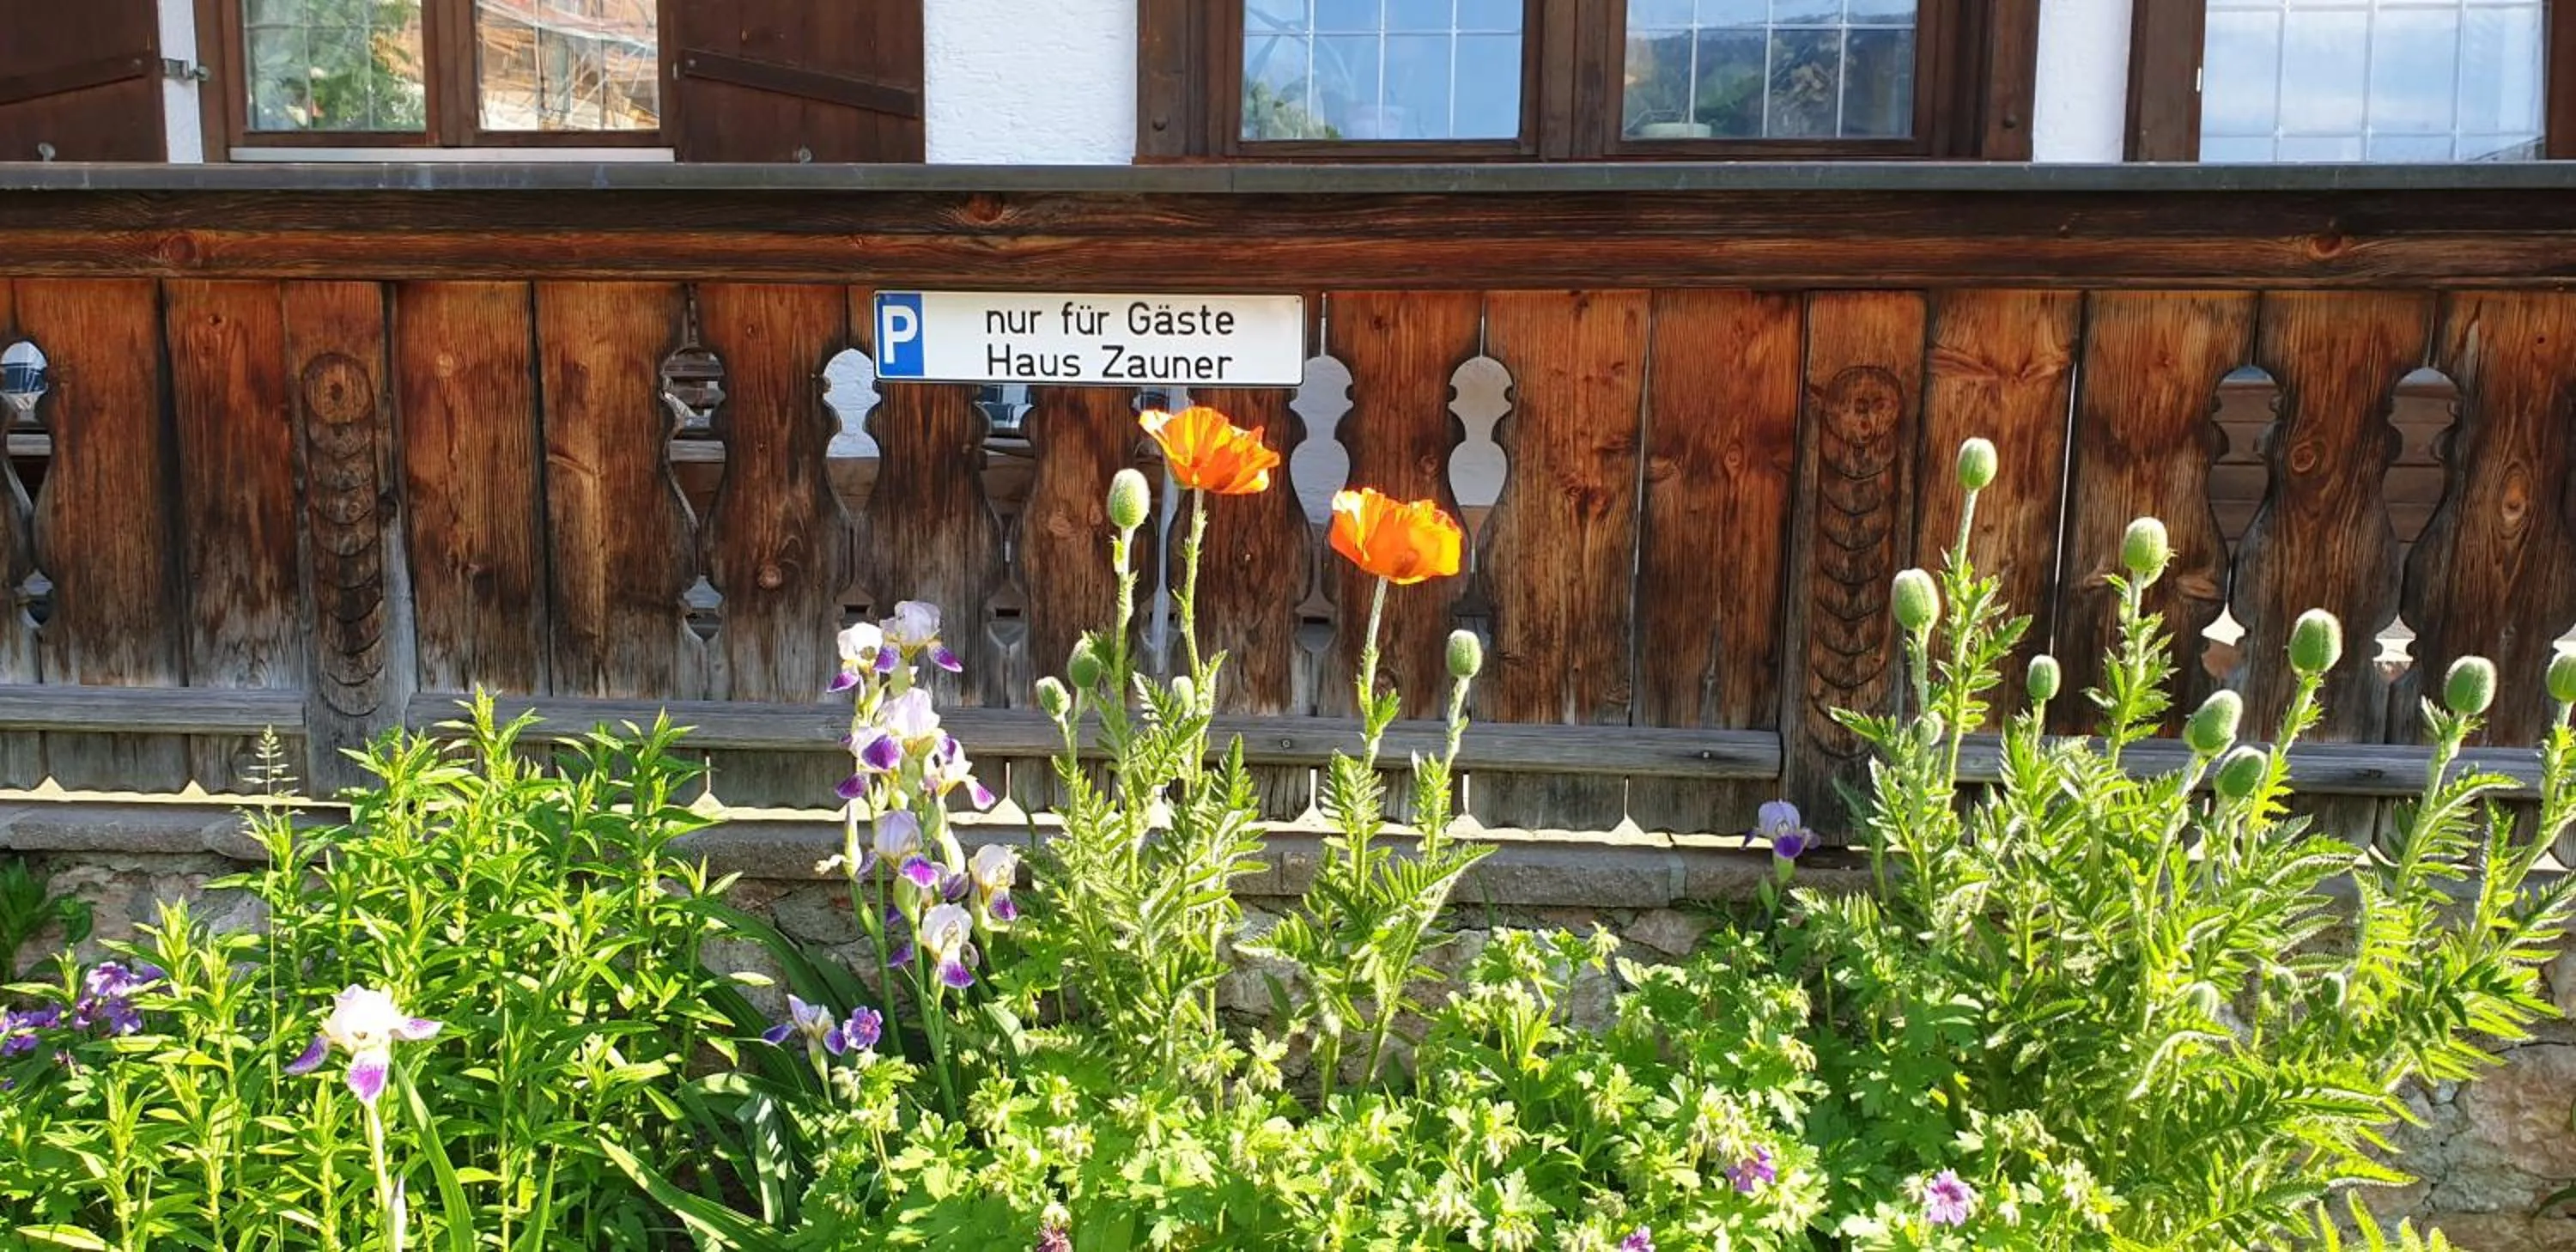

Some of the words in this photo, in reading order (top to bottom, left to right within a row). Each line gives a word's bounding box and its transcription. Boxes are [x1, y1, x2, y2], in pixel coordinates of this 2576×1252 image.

[882, 305, 918, 364] P
[986, 309, 1042, 334] nur
[1061, 301, 1110, 336] für
[1127, 301, 1235, 336] Gäste
[987, 343, 1081, 377] Haus
[1102, 344, 1233, 380] Zauner
